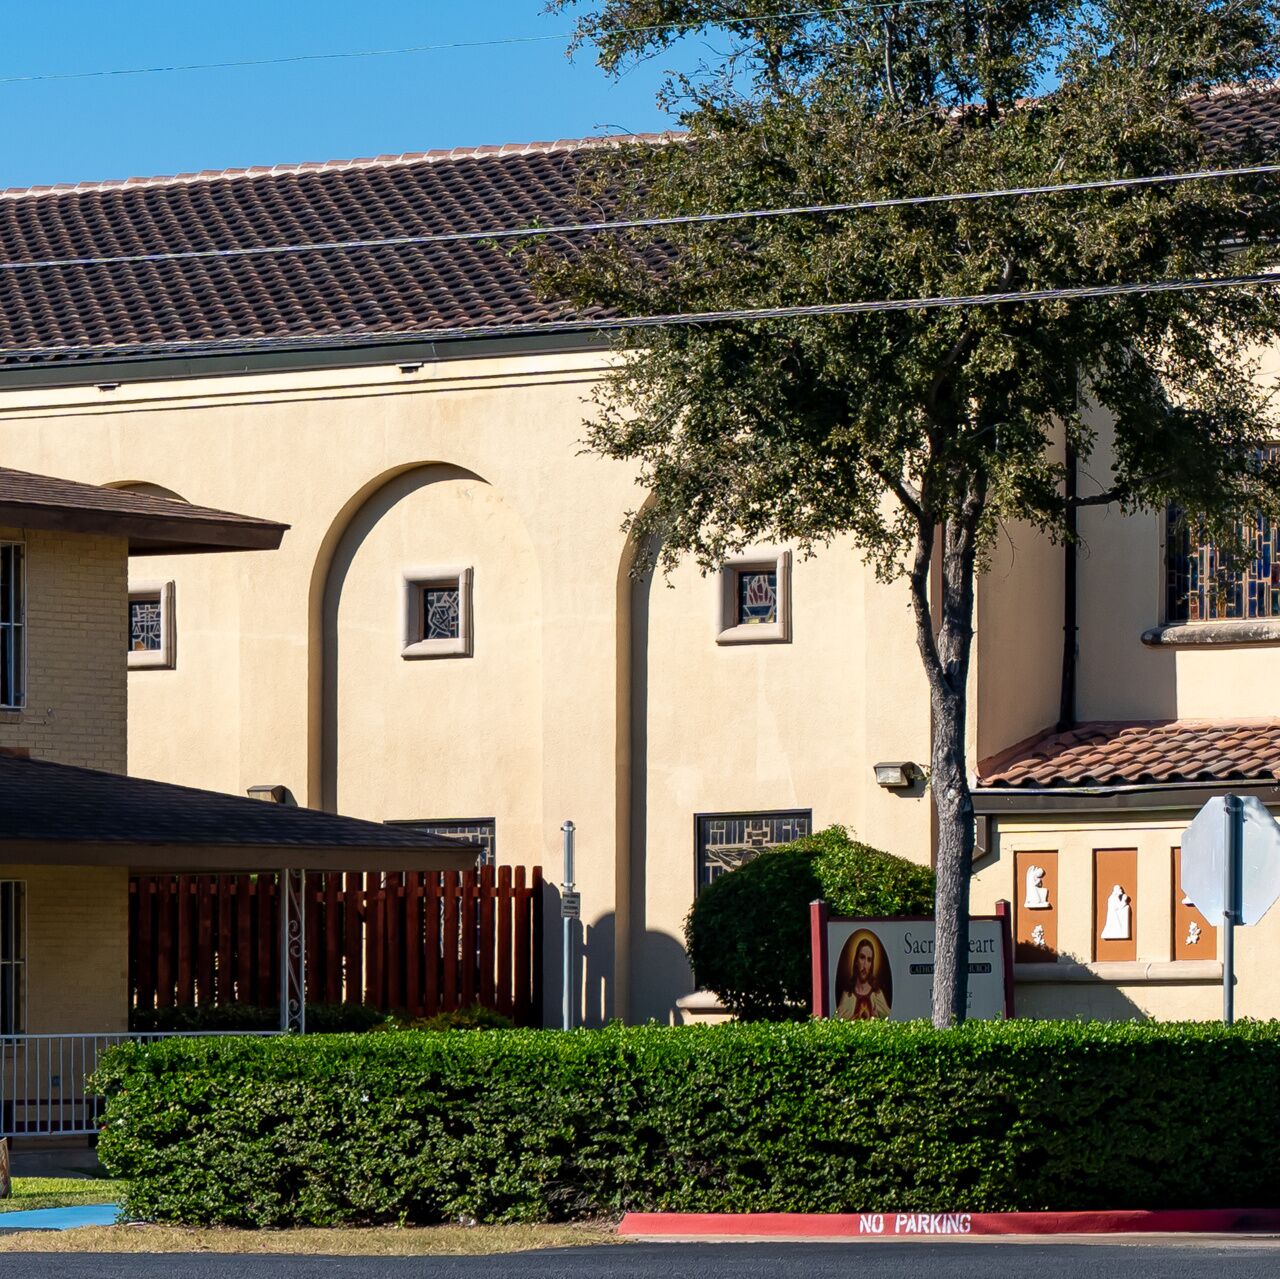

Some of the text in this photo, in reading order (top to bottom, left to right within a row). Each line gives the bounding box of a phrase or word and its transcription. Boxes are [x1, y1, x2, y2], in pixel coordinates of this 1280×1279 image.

[904, 932, 994, 954] Sacr eart
[860, 1214, 971, 1233] NO PARKING
